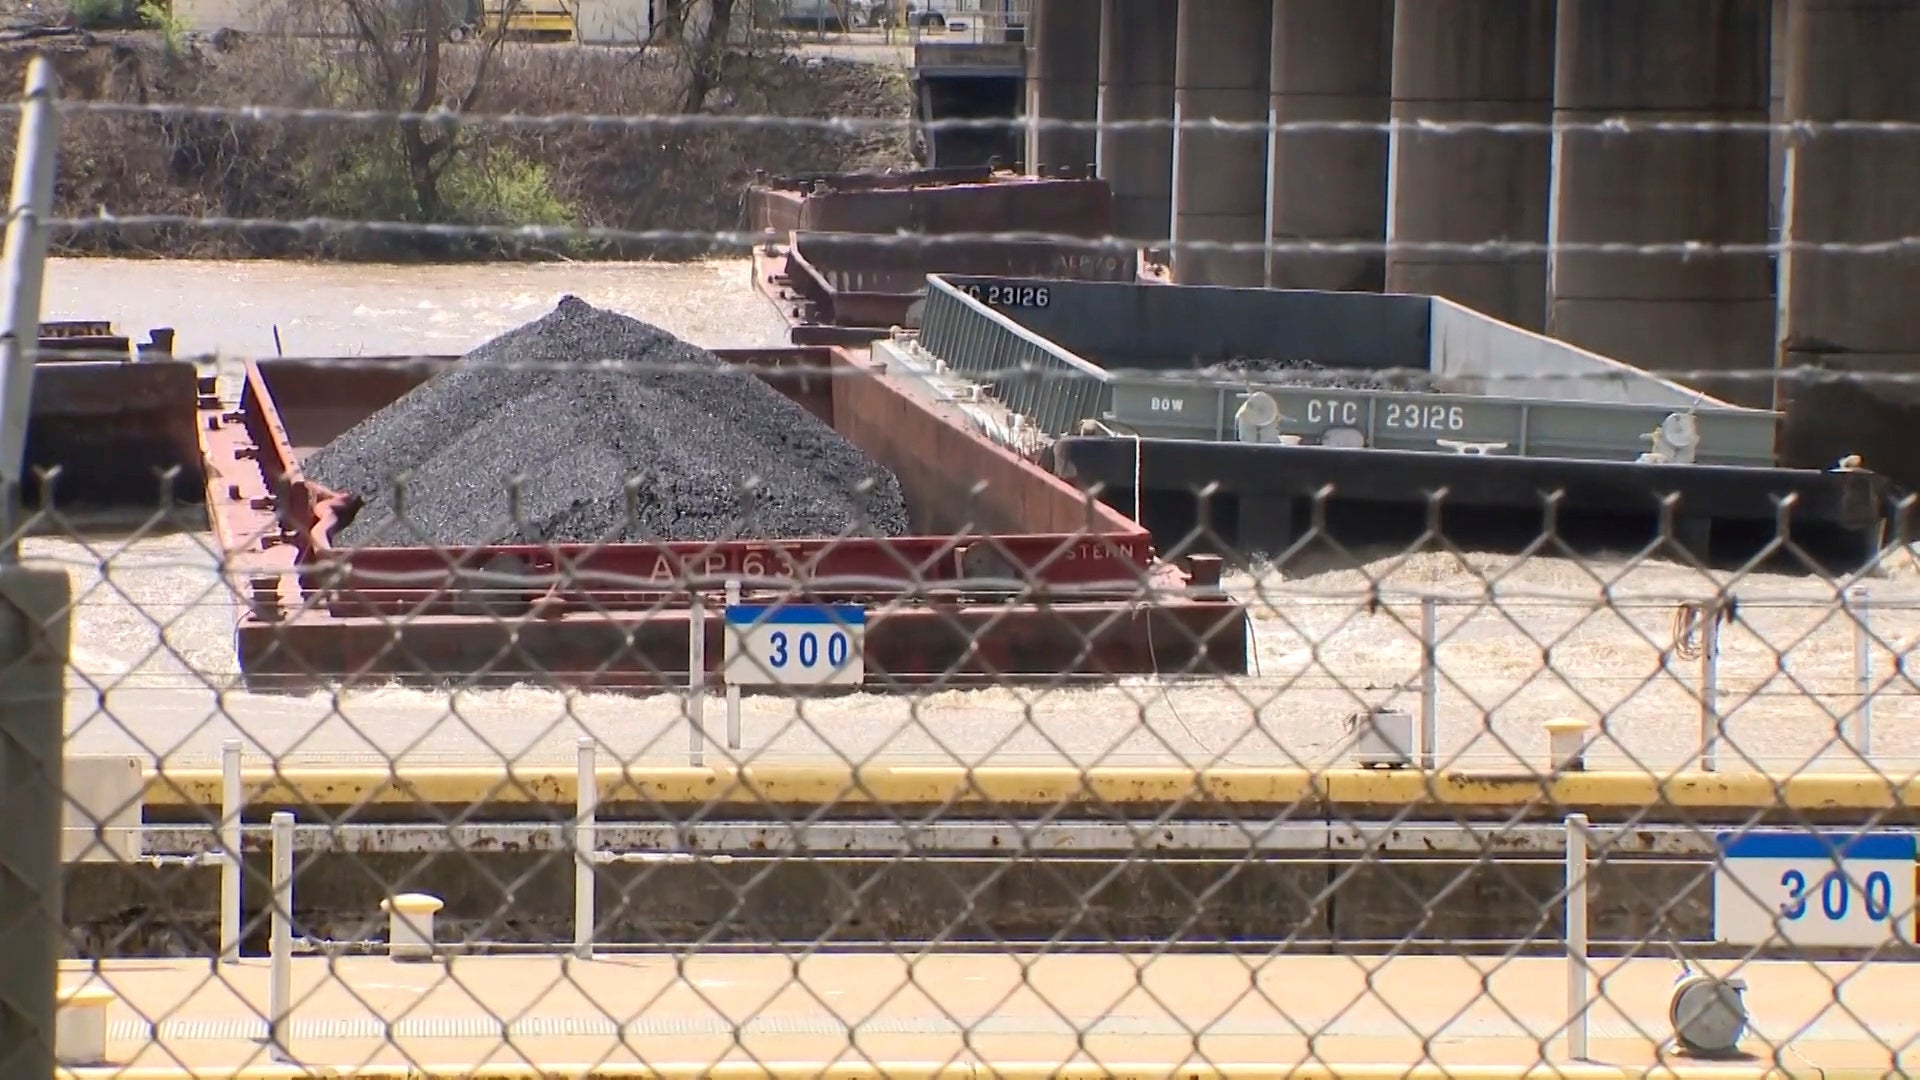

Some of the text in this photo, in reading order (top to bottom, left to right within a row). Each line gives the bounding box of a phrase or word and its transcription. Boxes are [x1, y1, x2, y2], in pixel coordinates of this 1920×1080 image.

[988, 285, 1049, 307] 23126
[1151, 396, 1184, 411] BOW
[1307, 399, 1464, 430] CTC 23126
[769, 631, 847, 668] 300
[1780, 869, 1891, 922] 300
